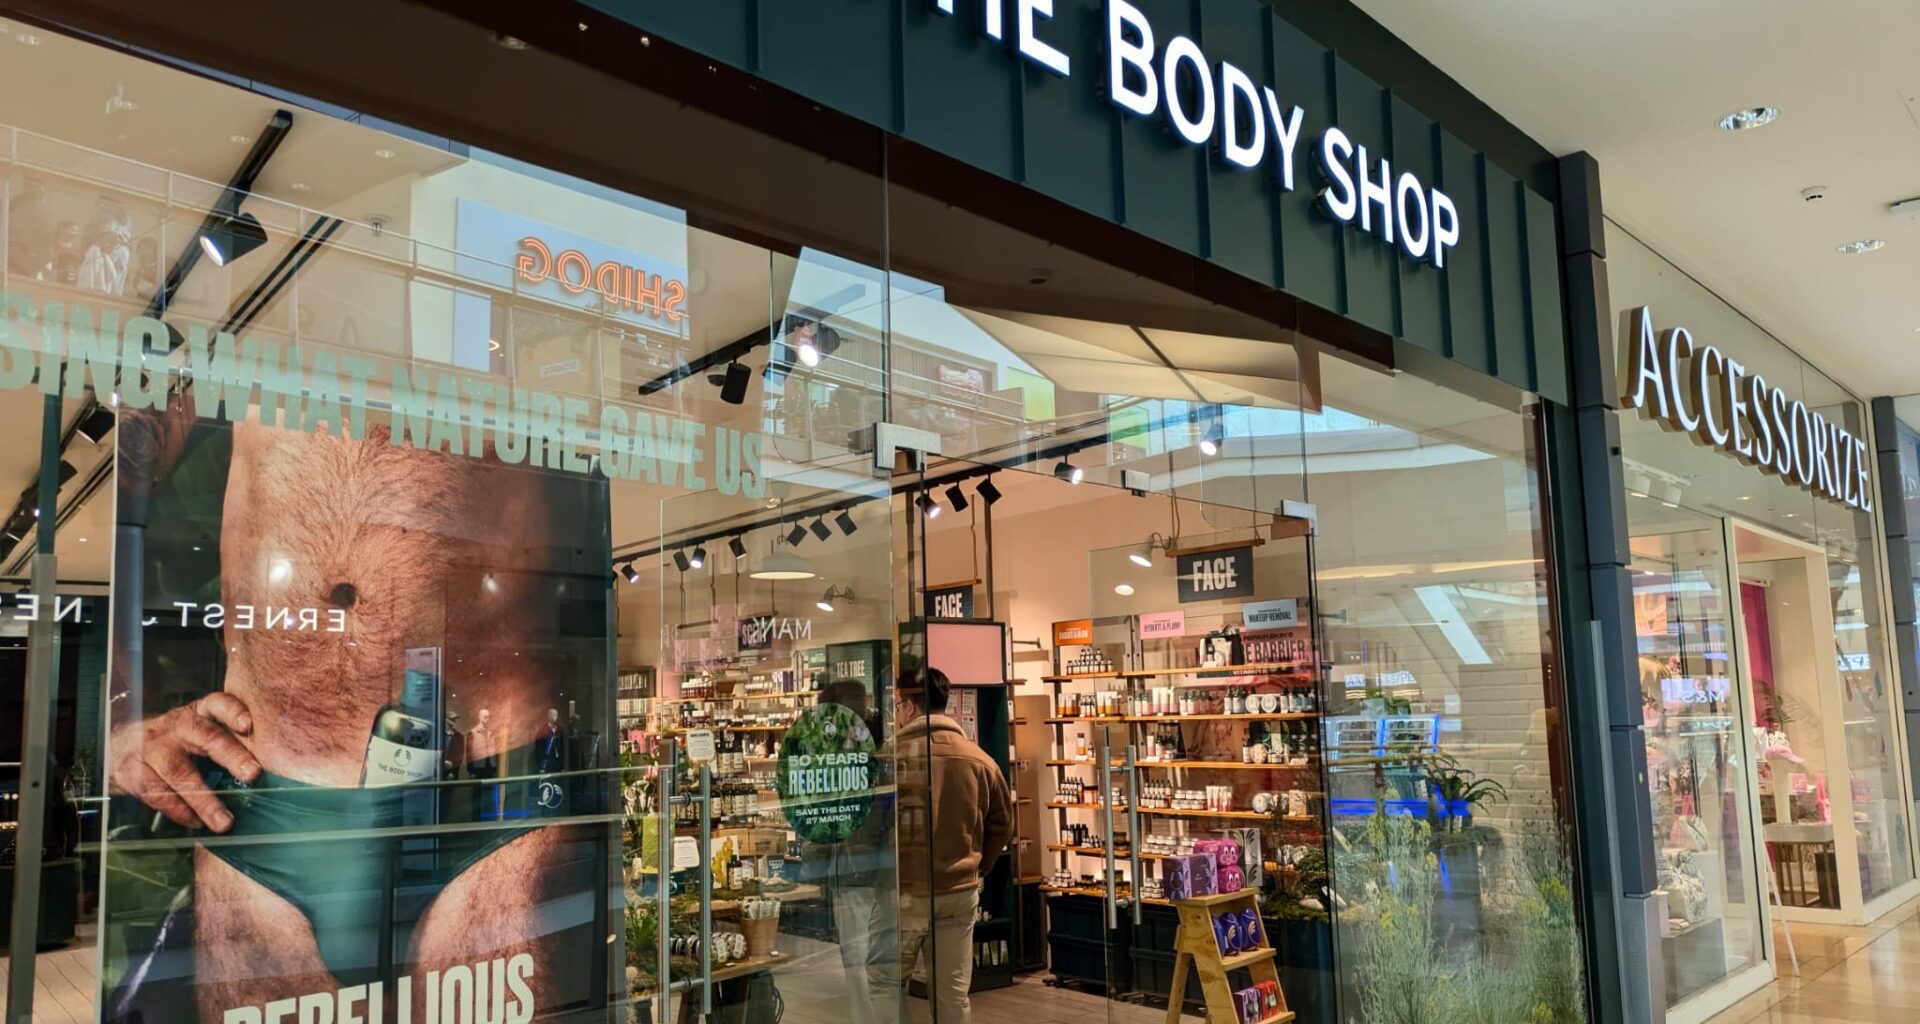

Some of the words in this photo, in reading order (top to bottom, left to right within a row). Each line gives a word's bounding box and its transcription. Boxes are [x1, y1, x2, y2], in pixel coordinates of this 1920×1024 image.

[1108, 0, 1305, 192] BODY
[1322, 126, 1459, 269] SHOP
[188, 325, 378, 441] WHAT
[389, 366, 590, 475] NATURE
[600, 405, 706, 491] GAVE
[715, 426, 766, 499] US
[1628, 305, 1872, 513] ACCESSORIZE
[1192, 556, 1237, 593] FACE
[934, 593, 963, 618] FACE
[1269, 611, 1292, 622] REMOVAL
[1255, 639, 1306, 663] BARRIER
[836, 662, 849, 679] TEA
[850, 660, 866, 677] TREE
[788, 754, 812, 768] 50
[815, 752, 869, 766] YEARS
[788, 766, 869, 796] REBELLIOUS
[795, 807, 819, 817] SAVE
[820, 806, 837, 815] THE
[838, 804, 861, 813] DATE
[819, 814, 852, 823] MARCH
